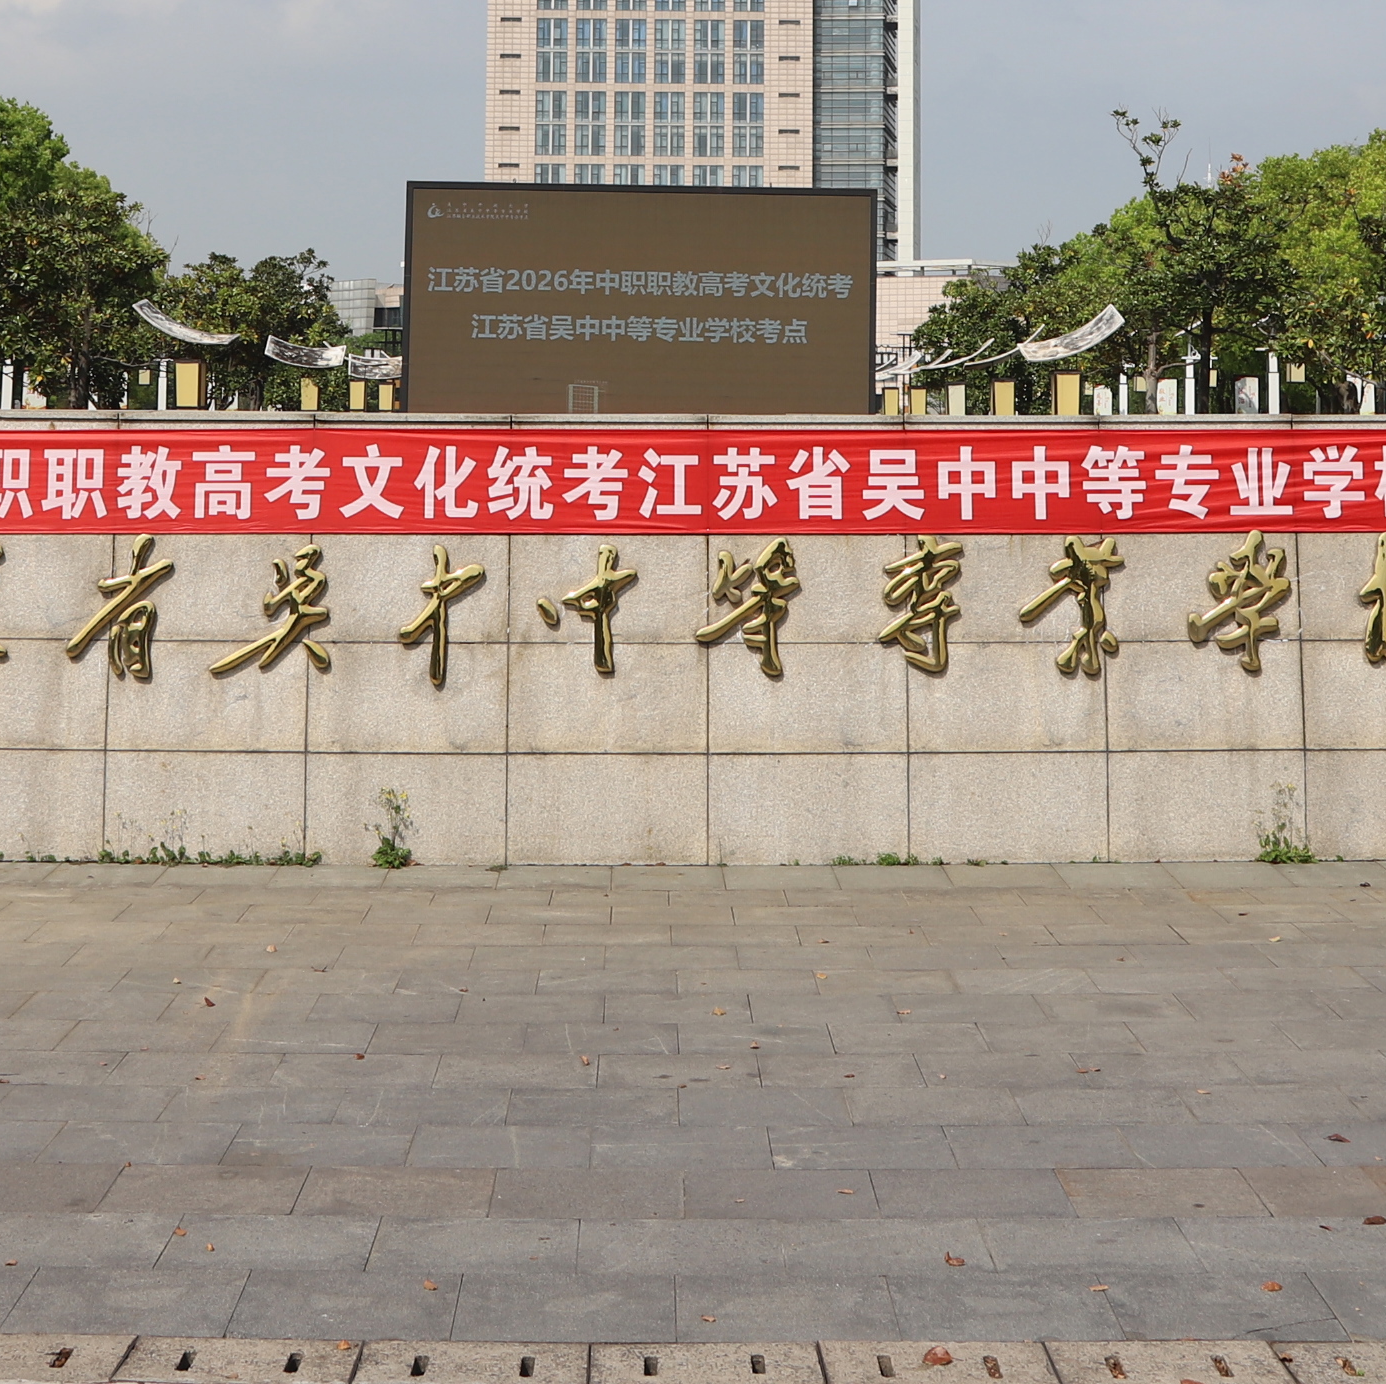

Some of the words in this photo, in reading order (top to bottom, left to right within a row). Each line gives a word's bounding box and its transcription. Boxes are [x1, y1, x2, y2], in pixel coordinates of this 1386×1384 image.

[427, 266, 854, 300] 江苏省2026年中职职教高考文化统考
[471, 314, 809, 345] 江苏省吴中中等专业学校考点
